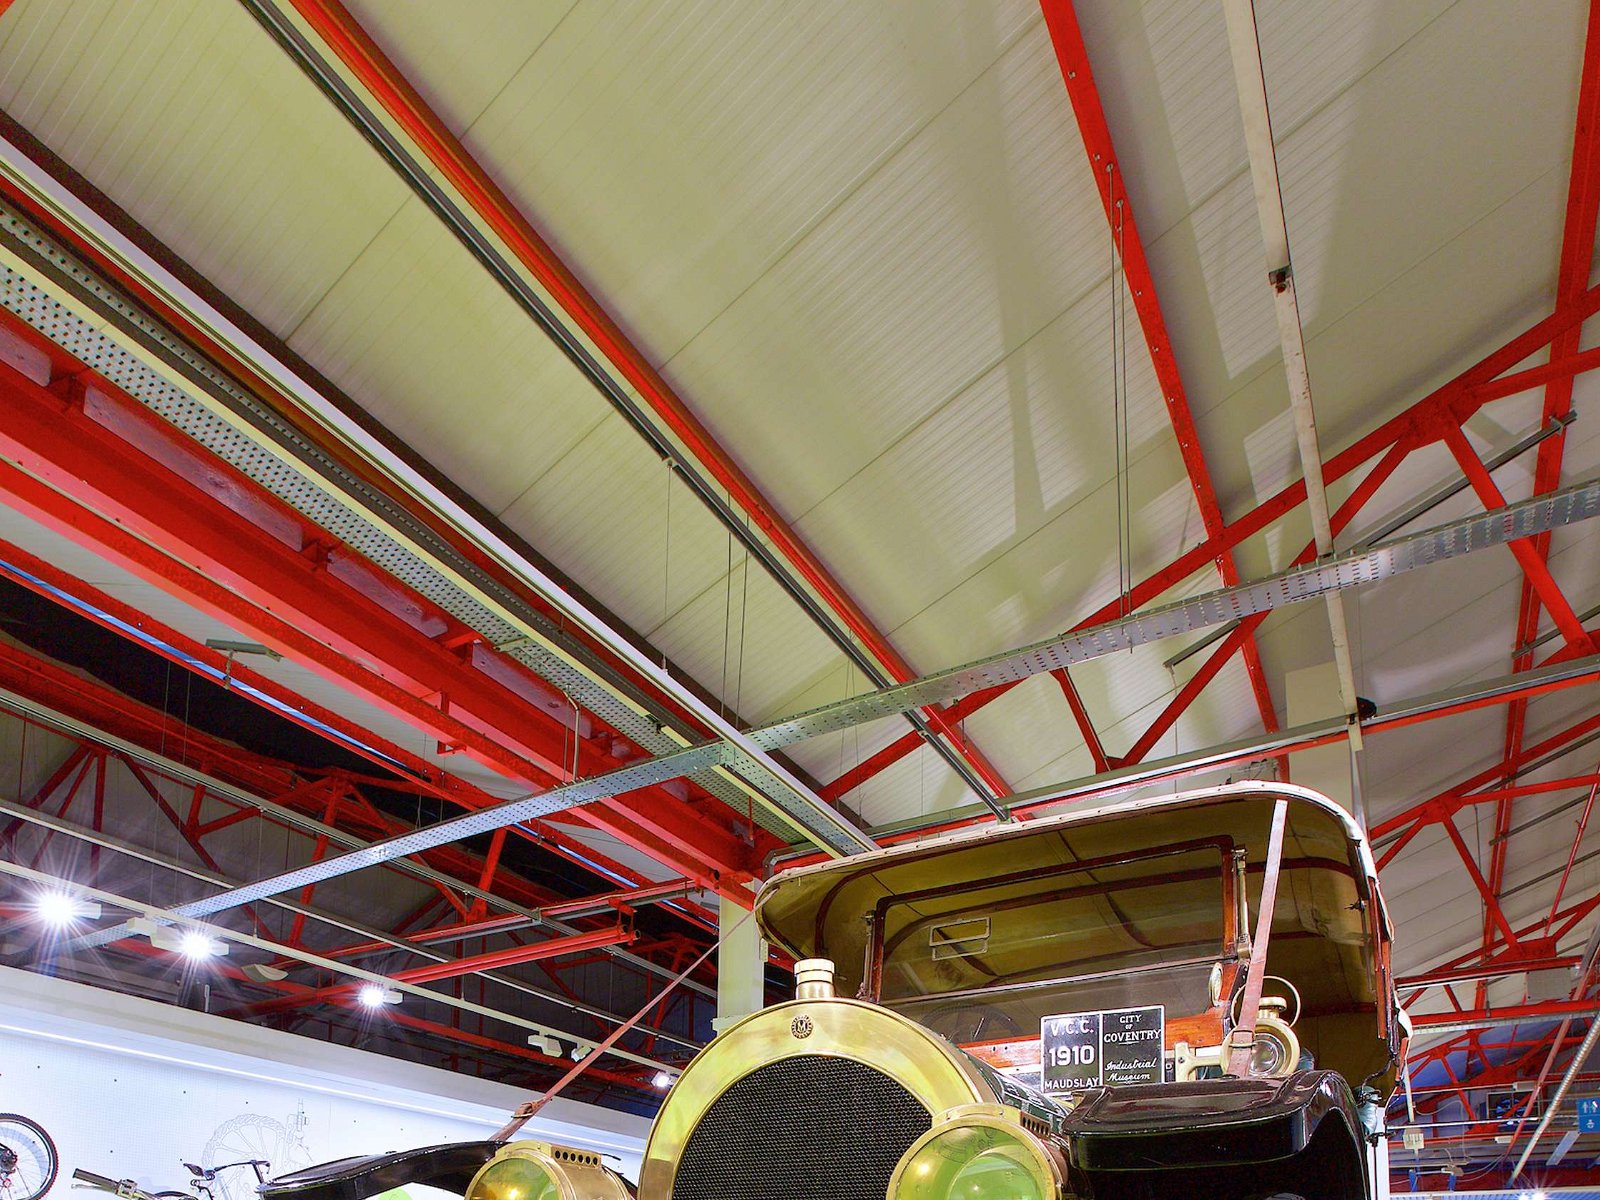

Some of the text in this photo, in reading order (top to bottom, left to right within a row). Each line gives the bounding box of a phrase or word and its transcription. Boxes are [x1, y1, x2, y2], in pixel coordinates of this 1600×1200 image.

[1119, 1014, 1142, 1024] CITY
[1051, 1020, 1094, 1037] V.C.C.
[1103, 1029, 1161, 1043] COVENTRY
[1049, 1045, 1095, 1067] 1910
[1104, 1057, 1157, 1071] Industrial
[1044, 1077, 1099, 1090] MAUDSLAY
[1106, 1072, 1151, 1082] Museum
